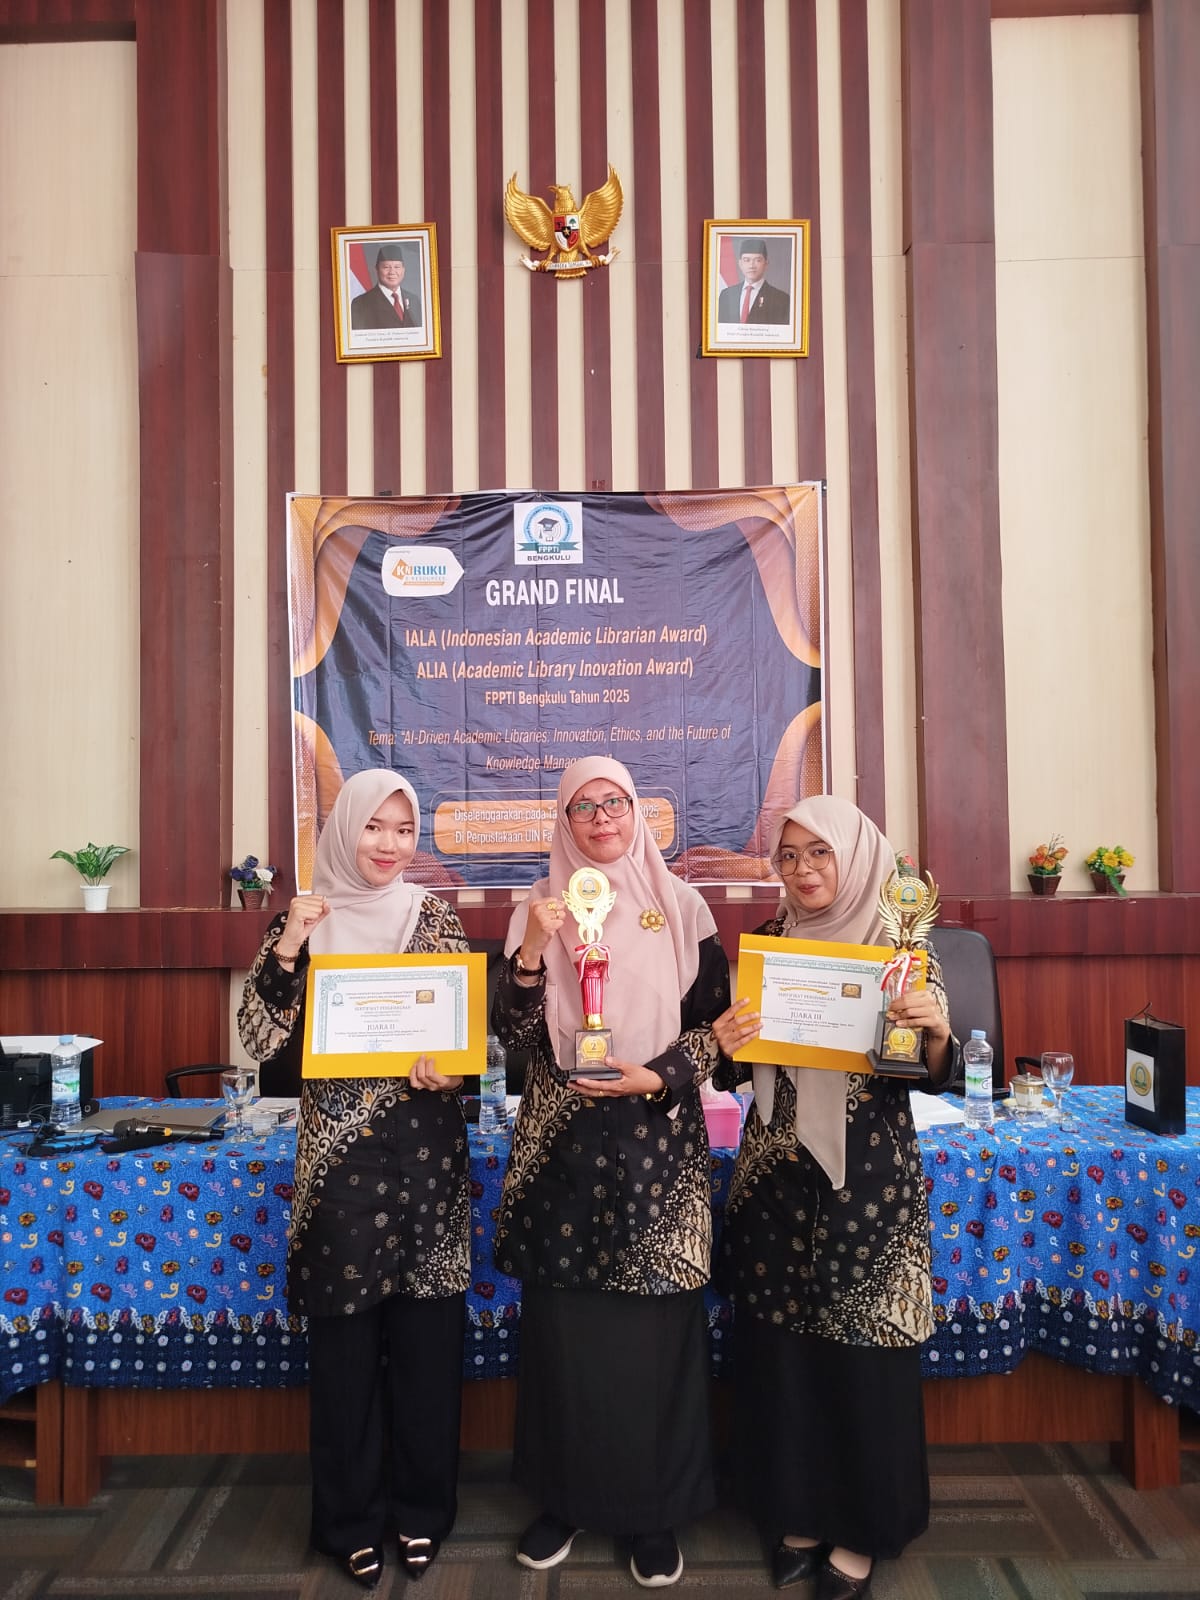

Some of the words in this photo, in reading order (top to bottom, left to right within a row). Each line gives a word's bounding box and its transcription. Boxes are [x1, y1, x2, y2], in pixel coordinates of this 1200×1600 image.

[527, 554, 571, 562] BENGKULU
[485, 579, 559, 607] GRAND
[565, 578, 625, 605] FINAL
[405, 629, 437, 647] IALA
[441, 628, 521, 652] (Indonesian
[524, 627, 592, 646] Academic
[595, 626, 656, 645] Librarian
[659, 624, 708, 646] Award)
[416, 661, 448, 679] ALIA
[452, 661, 524, 683] (Academic
[527, 659, 576, 682] Library
[579, 658, 642, 677] Inovation
[645, 657, 694, 679] Award)
[485, 691, 516, 705] FPPTI
[518, 690, 567, 708] Bengkulu
[569, 690, 600, 704] Tahun
[603, 689, 630, 703] 2025
[368, 730, 397, 745] Tema:
[453, 729, 501, 744] Academic
[553, 727, 607, 744] Innovation,
[610, 726, 643, 743] Ethics,
[646, 726, 665, 741] and
[668, 725, 684, 741] the
[686, 724, 719, 741] Future
[721, 724, 732, 740] of
[486, 755, 541, 773] Knowledge
[455, 808, 522, 823] Diselenggarakan
[525, 808, 546, 822] pada
[639, 805, 659, 818] 025
[455, 831, 465, 844] Di
[466, 829, 523, 846] Perpustakaan
[525, 828, 540, 842] UIN
[791, 1011, 813, 1020] JUARA
[367, 1023, 389, 1031] JUARA
